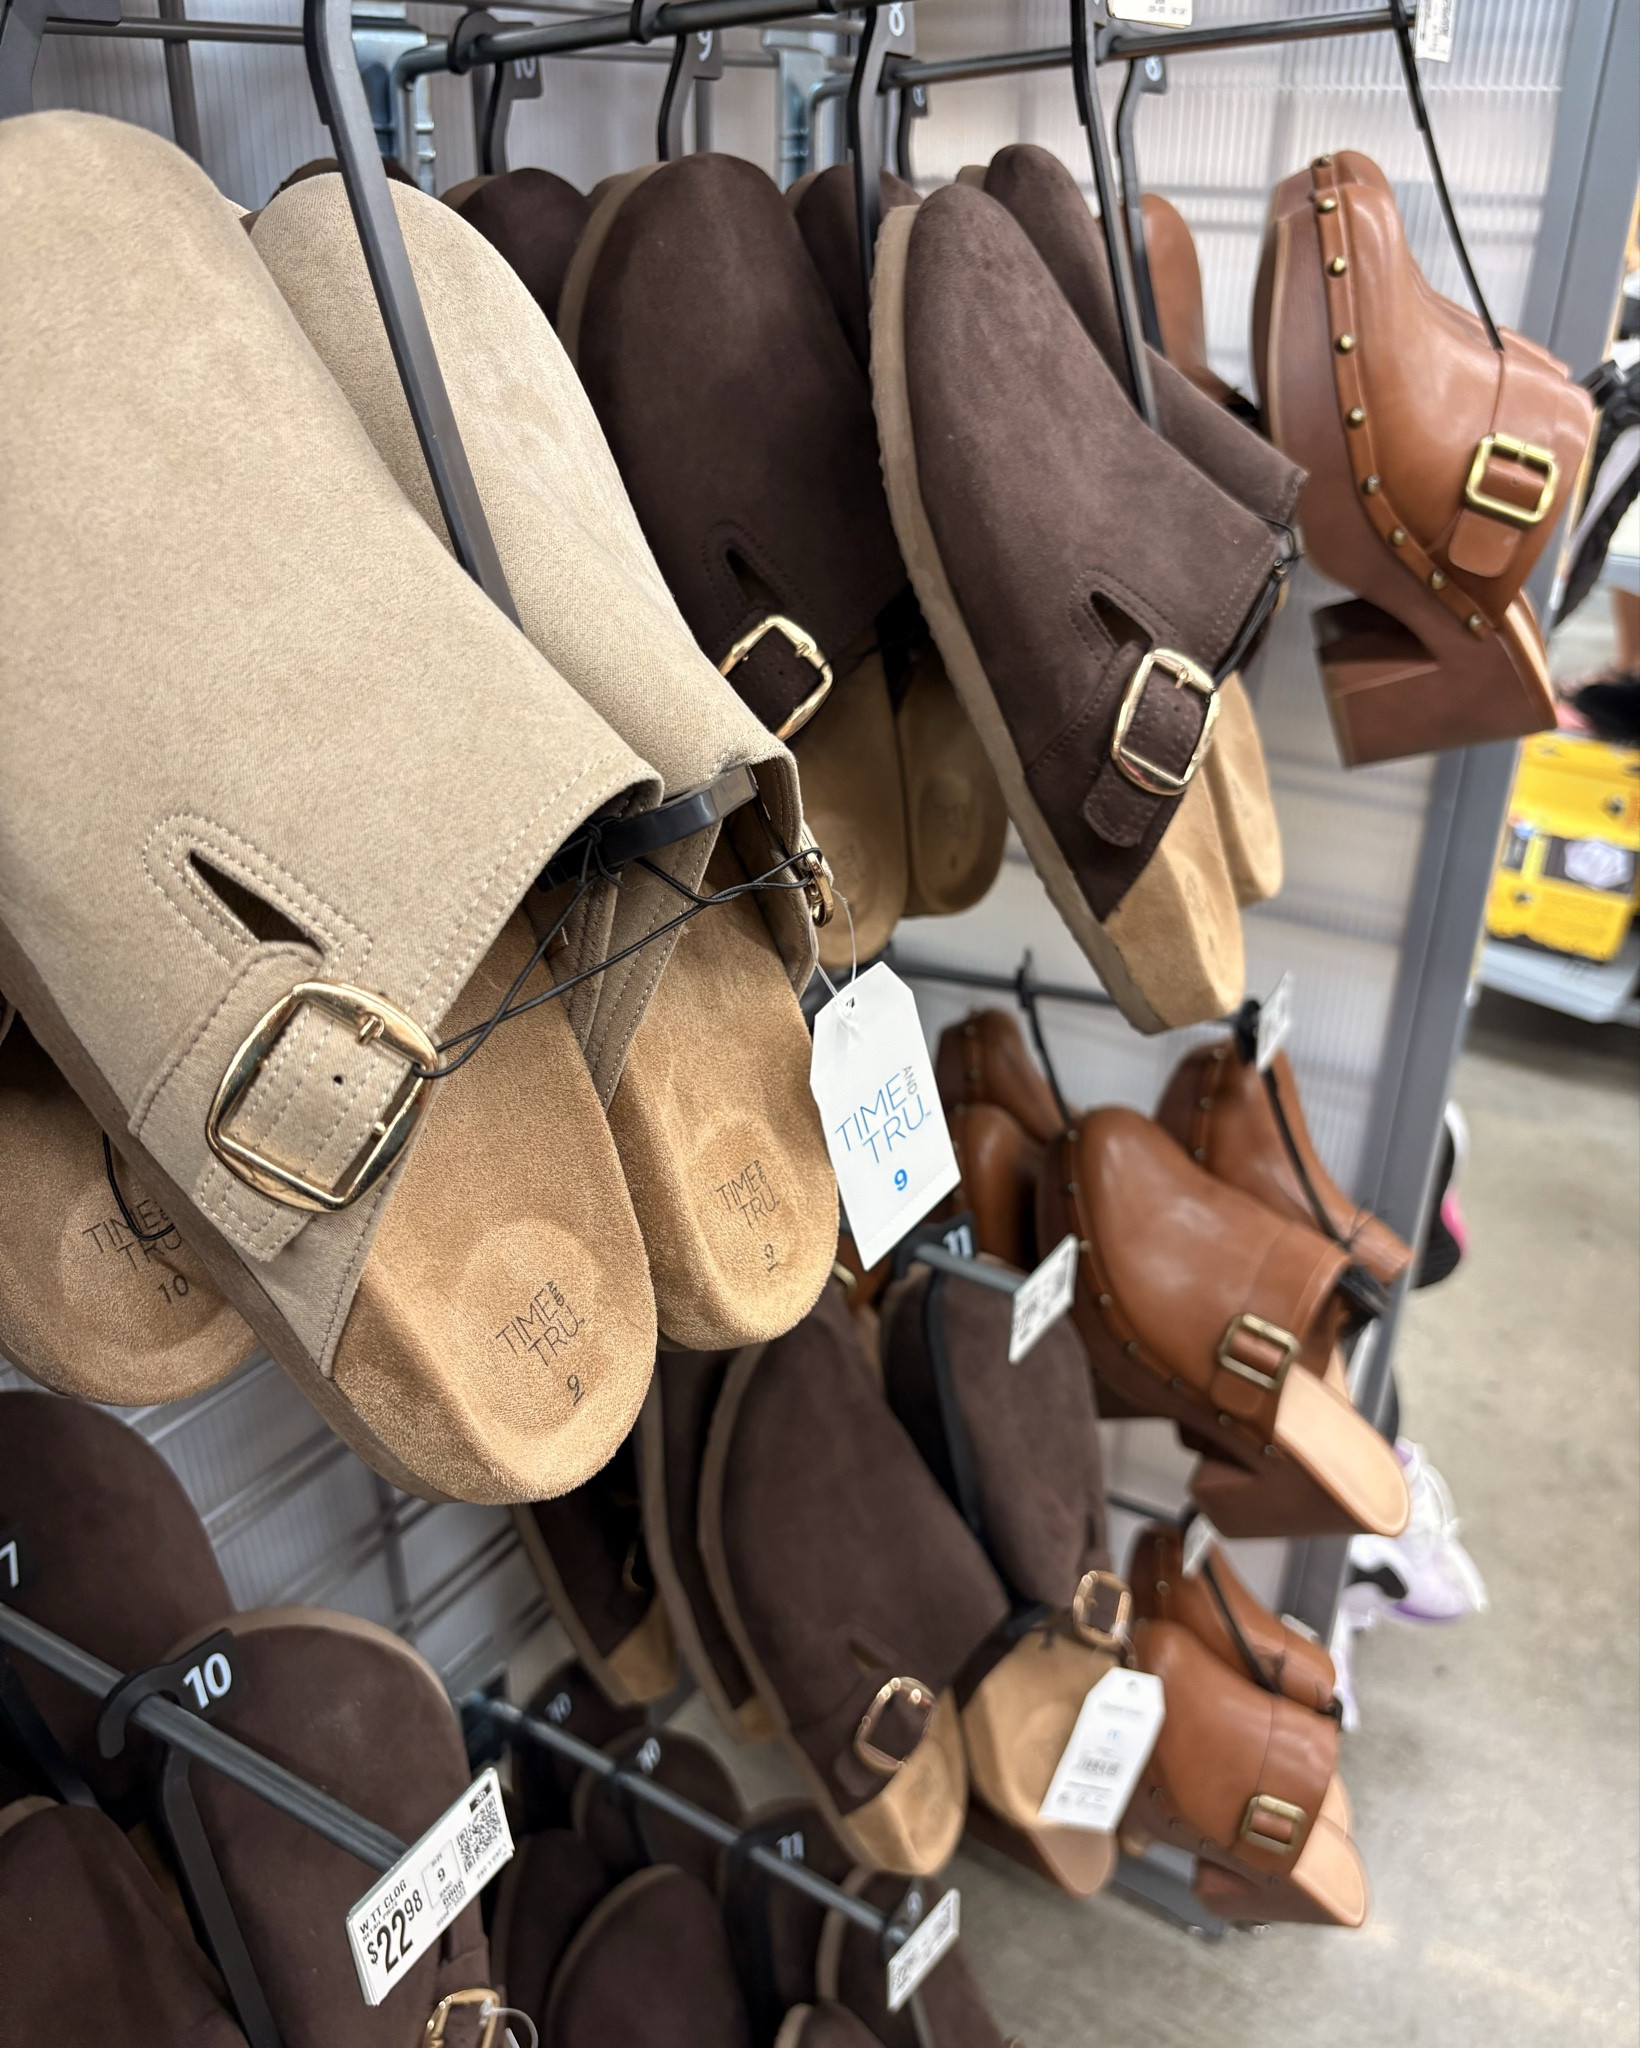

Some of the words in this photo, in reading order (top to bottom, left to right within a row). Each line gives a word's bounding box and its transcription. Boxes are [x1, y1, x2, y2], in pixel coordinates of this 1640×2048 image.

[835, 1072, 908, 1151] TIME
[903, 1065, 918, 1095] AND
[862, 1094, 925, 1164] TRU
[716, 1163, 761, 1212] TIME
[894, 1168, 908, 1191] 9
[740, 1184, 777, 1230] TRU
[943, 1224, 973, 1259] 11
[158, 1274, 189, 1304] 10
[496, 1288, 558, 1356] TIME
[528, 1305, 579, 1367] TRU
[567, 1374, 581, 1401] 9
[182, 1652, 232, 1710] 10
[359, 1919, 370, 1935] W
[383, 1879, 407, 1909] CLOG
